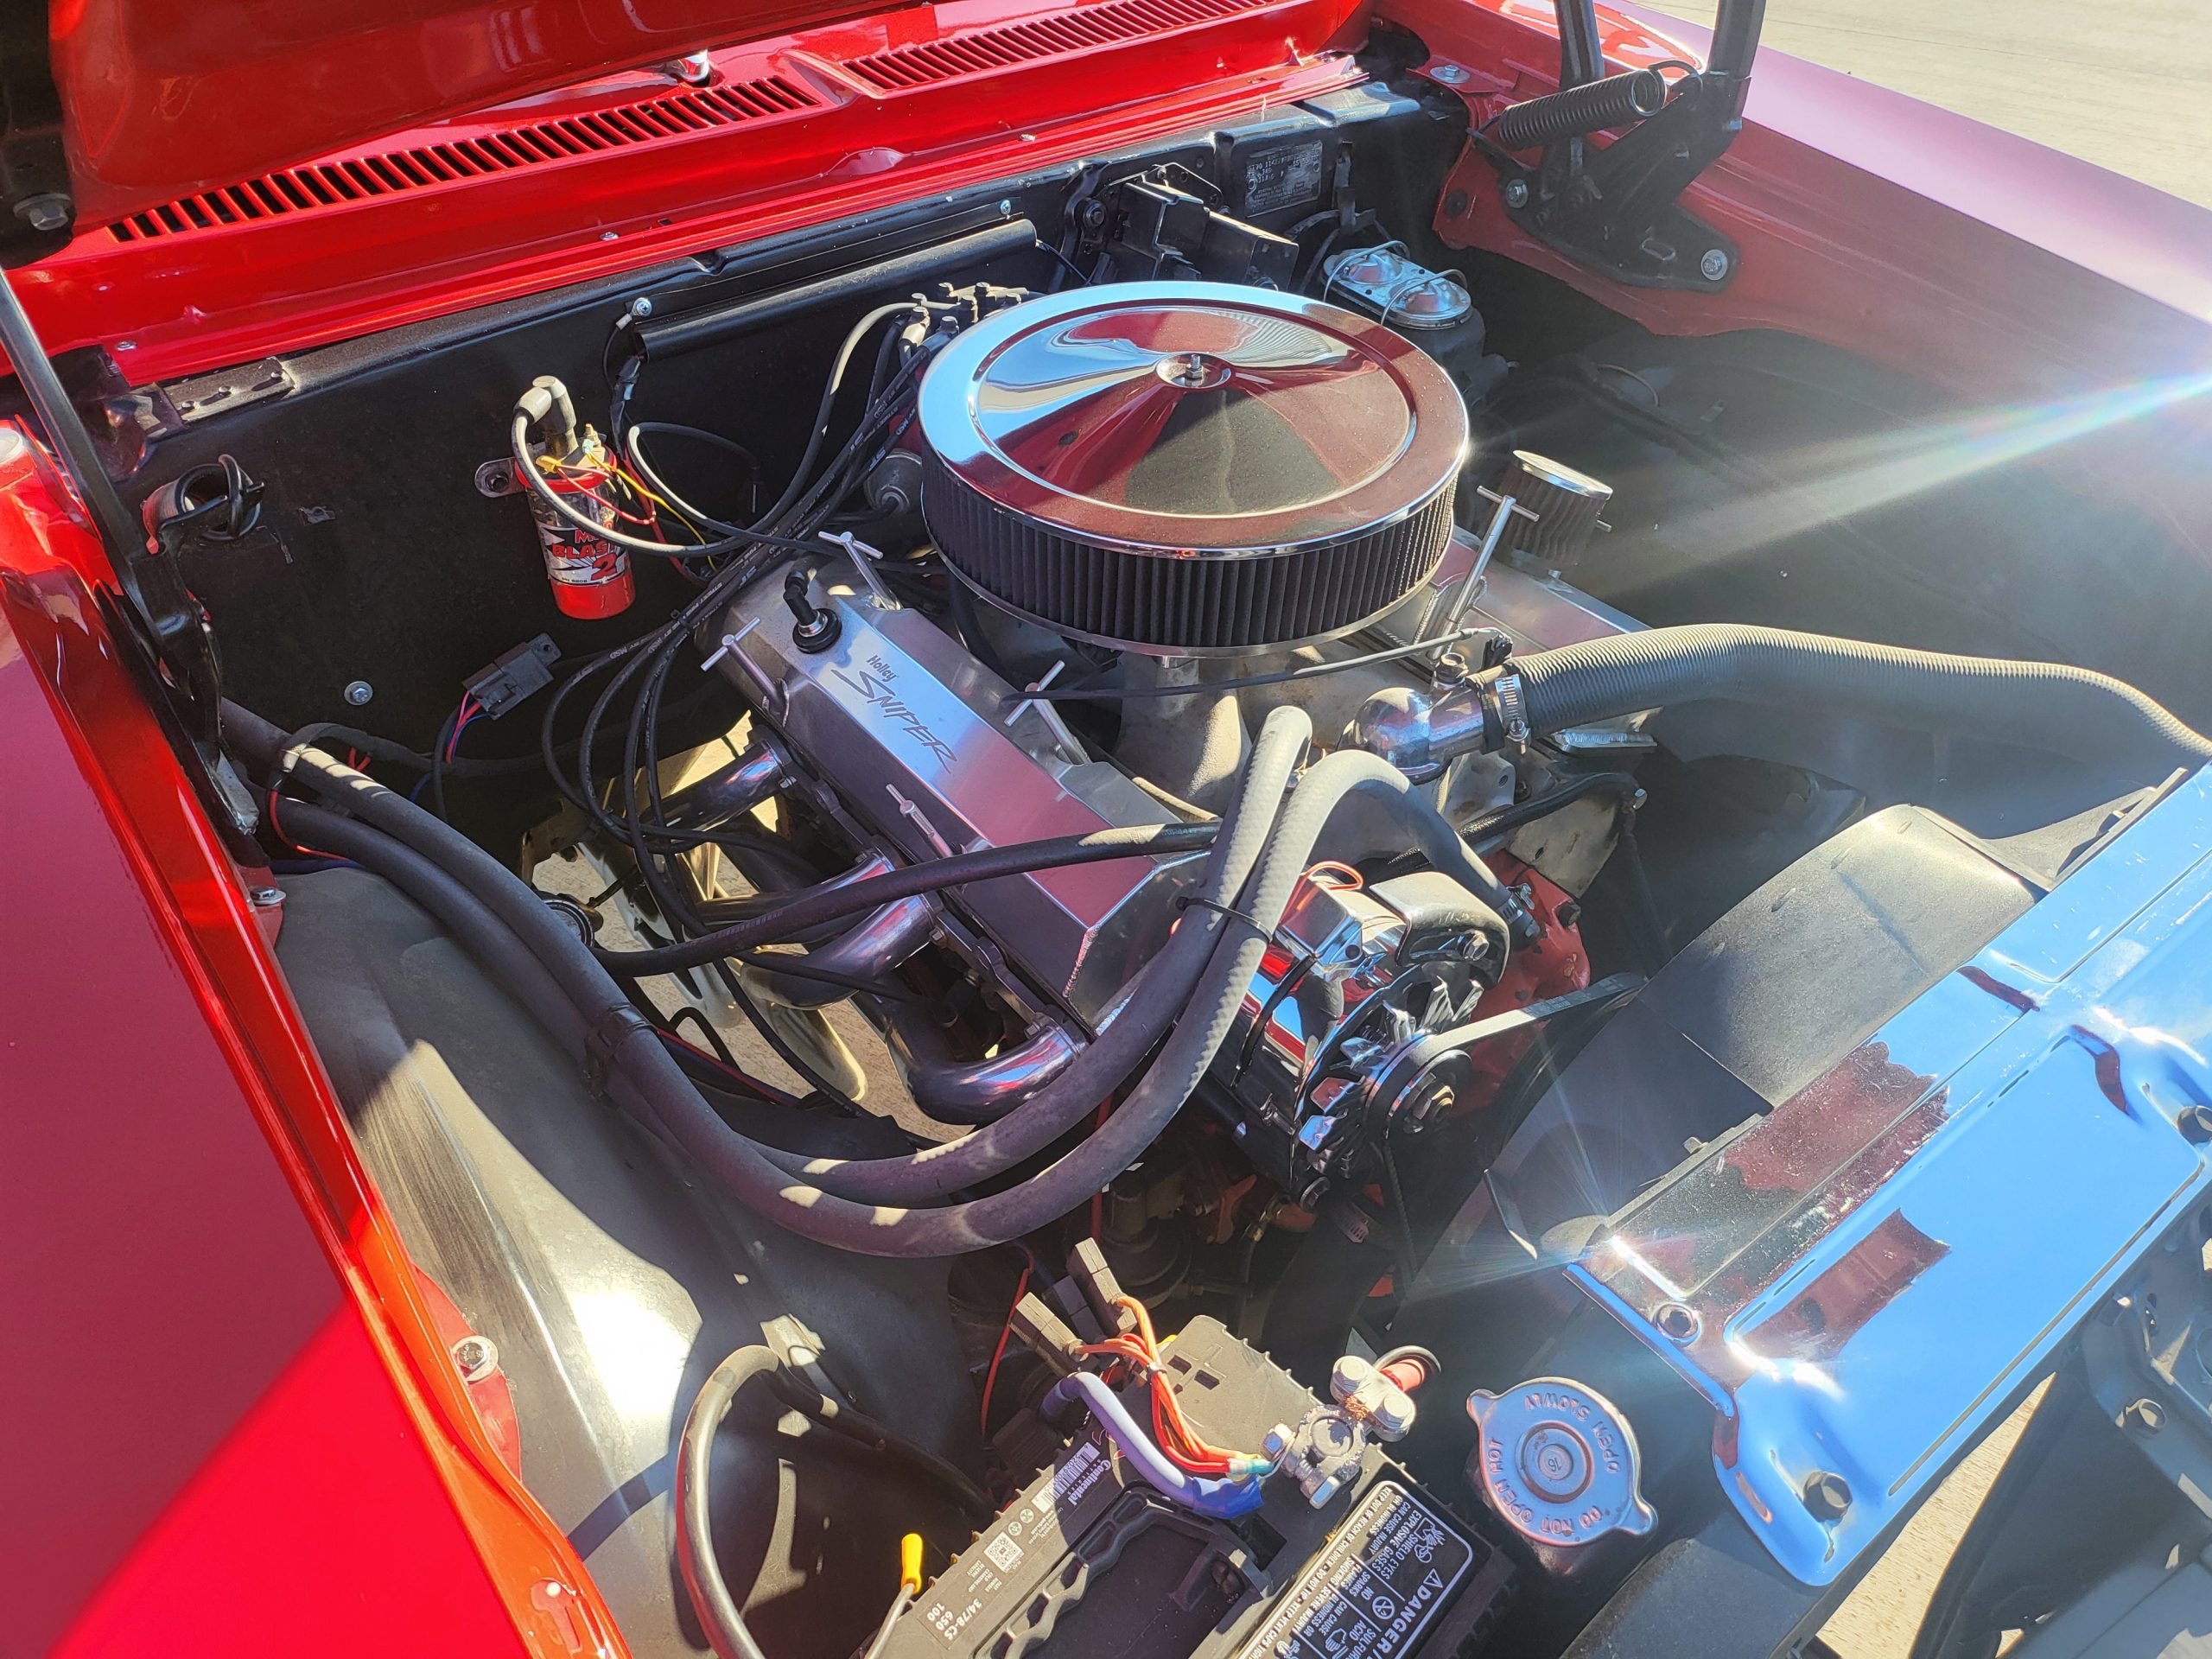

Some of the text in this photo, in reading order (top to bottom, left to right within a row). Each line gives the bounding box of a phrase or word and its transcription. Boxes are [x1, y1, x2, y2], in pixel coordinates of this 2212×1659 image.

[894, 417, 909, 435] MSD
[591, 552, 618, 581] 2
[608, 645, 627, 659] MSD
[866, 655, 898, 682] Holley
[830, 669, 957, 774] SNIPER
[1525, 1393, 1620, 1473] OPEN SLOWLY
[1548, 1457, 1562, 1472] 16
[1068, 1459, 1112, 1506] Continental
[1489, 1437, 1604, 1536] DO NOT OPEN HOT
[1363, 1509, 1374, 1519] OF
[1368, 1494, 1402, 1535] OR BLINDNESS
[1370, 1498, 1382, 1511] OUT
[1344, 1532, 1354, 1542] OF
[1351, 1516, 1368, 1535] REACH
[1367, 1500, 1411, 1554] CAN CAUSE INJURY
[1325, 1539, 1349, 1567] CHILDREN
[1370, 1510, 1421, 1572] EXPLOSIVE GASES
[1379, 1533, 1419, 1580] SHIELD EYES
[1306, 1576, 1319, 1590] NOT
[1315, 1568, 1326, 1579] DO
[1329, 1556, 1354, 1586] SMOKING
[1339, 1563, 1363, 1590] FLAMES
[1348, 1570, 1370, 1596] SPARKS
[1299, 1587, 1311, 1599] TIP
[1359, 1586, 1374, 1600] NO
[925, 1601, 945, 1622] 100
[934, 1609, 954, 1630] 650
[943, 1598, 982, 1641] 34/78-CS
[1284, 1600, 1300, 1618] KEEP
[1293, 1586, 1331, 1631] SEVERE INJURY
[1303, 1592, 1339, 1637] BLINDNESS OR
[1318, 1599, 1347, 1635] CAN CAUSE
[1260, 1629, 1276, 1646] CAPS
[1347, 1619, 1367, 1641] ACID
[1348, 1627, 1376, 1657] SULFUR
